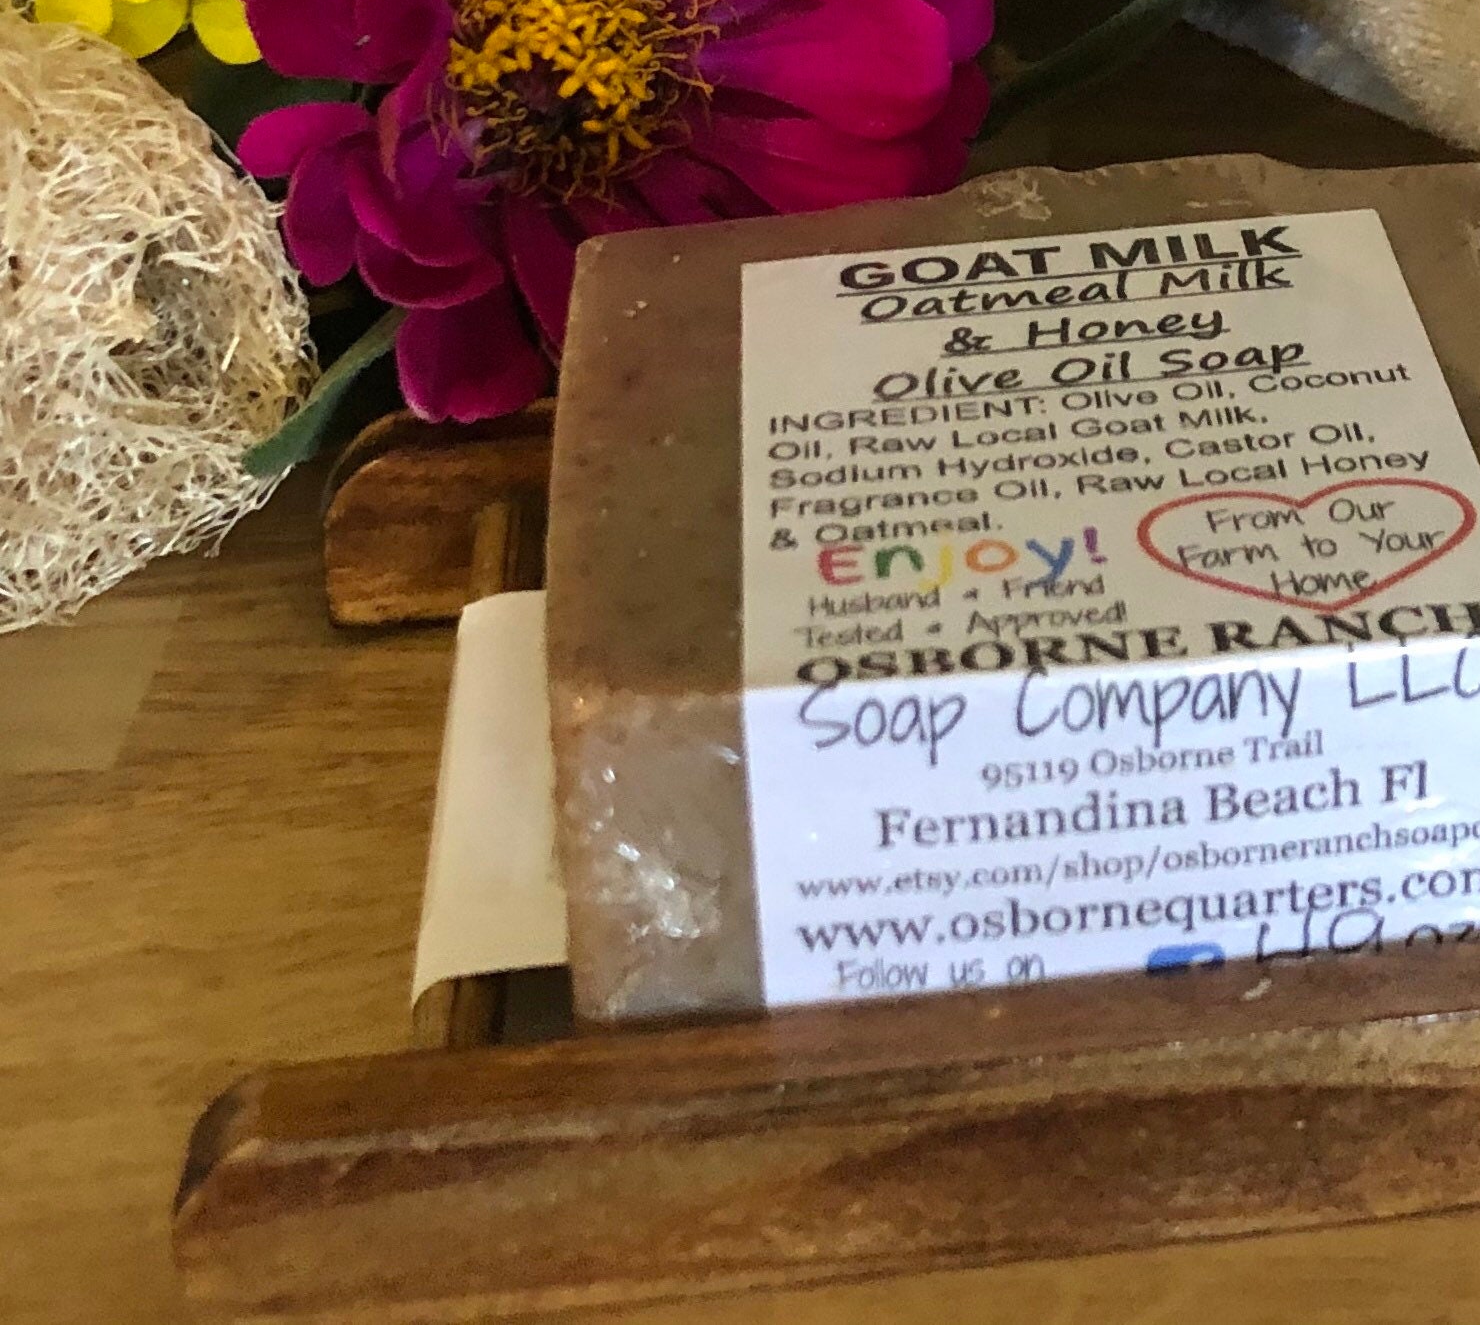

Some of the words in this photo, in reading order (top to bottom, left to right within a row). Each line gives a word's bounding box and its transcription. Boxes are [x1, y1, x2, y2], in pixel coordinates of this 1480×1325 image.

[838, 244, 1063, 293] GOAT
[1090, 224, 1301, 270] MILK
[860, 269, 1129, 324] Oatmeal
[1159, 260, 1293, 297] Milk
[942, 326, 993, 357] &
[1027, 307, 1227, 350] Honey
[768, 394, 1049, 435] INGREDIENT:
[1062, 386, 1158, 412] Olive
[1249, 362, 1412, 395] Coconut
[874, 366, 1025, 402] Olive
[1051, 353, 1133, 385] Oil
[1160, 336, 1307, 379] Soap
[769, 461, 923, 491] Sodium
[1165, 429, 1294, 458] Castor
[848, 429, 940, 456] Raw
[950, 421, 1058, 449] Local
[1071, 410, 1167, 439] Goat
[770, 488, 981, 521] Fragrance
[1077, 467, 1167, 496] Raw
[1182, 458, 1288, 488] Local
[1300, 445, 1431, 481] Honey
[769, 526, 799, 551] &
[1205, 502, 1305, 533] From
[1327, 496, 1396, 523] Our
[817, 525, 1110, 595] Enjoy!
[1178, 539, 1278, 570] Farm
[1299, 530, 1336, 558] to
[1358, 526, 1444, 558] Your
[807, 584, 942, 619] Husband
[1002, 573, 1106, 601] Friend
[1269, 564, 1373, 600] Home
[795, 617, 905, 650] Tested
[795, 623, 1190, 686] OSBORNE
[797, 680, 970, 767] Soap
[1014, 665, 1305, 750] Company
[980, 757, 1079, 794] 95119
[1090, 743, 1237, 779] Osborne
[1242, 730, 1325, 763] Trail
[875, 792, 1188, 851] Fernandina
[1205, 770, 1362, 826] Beach
[835, 952, 930, 993] Follow
[950, 955, 987, 987] us
[1006, 949, 1047, 982] on
